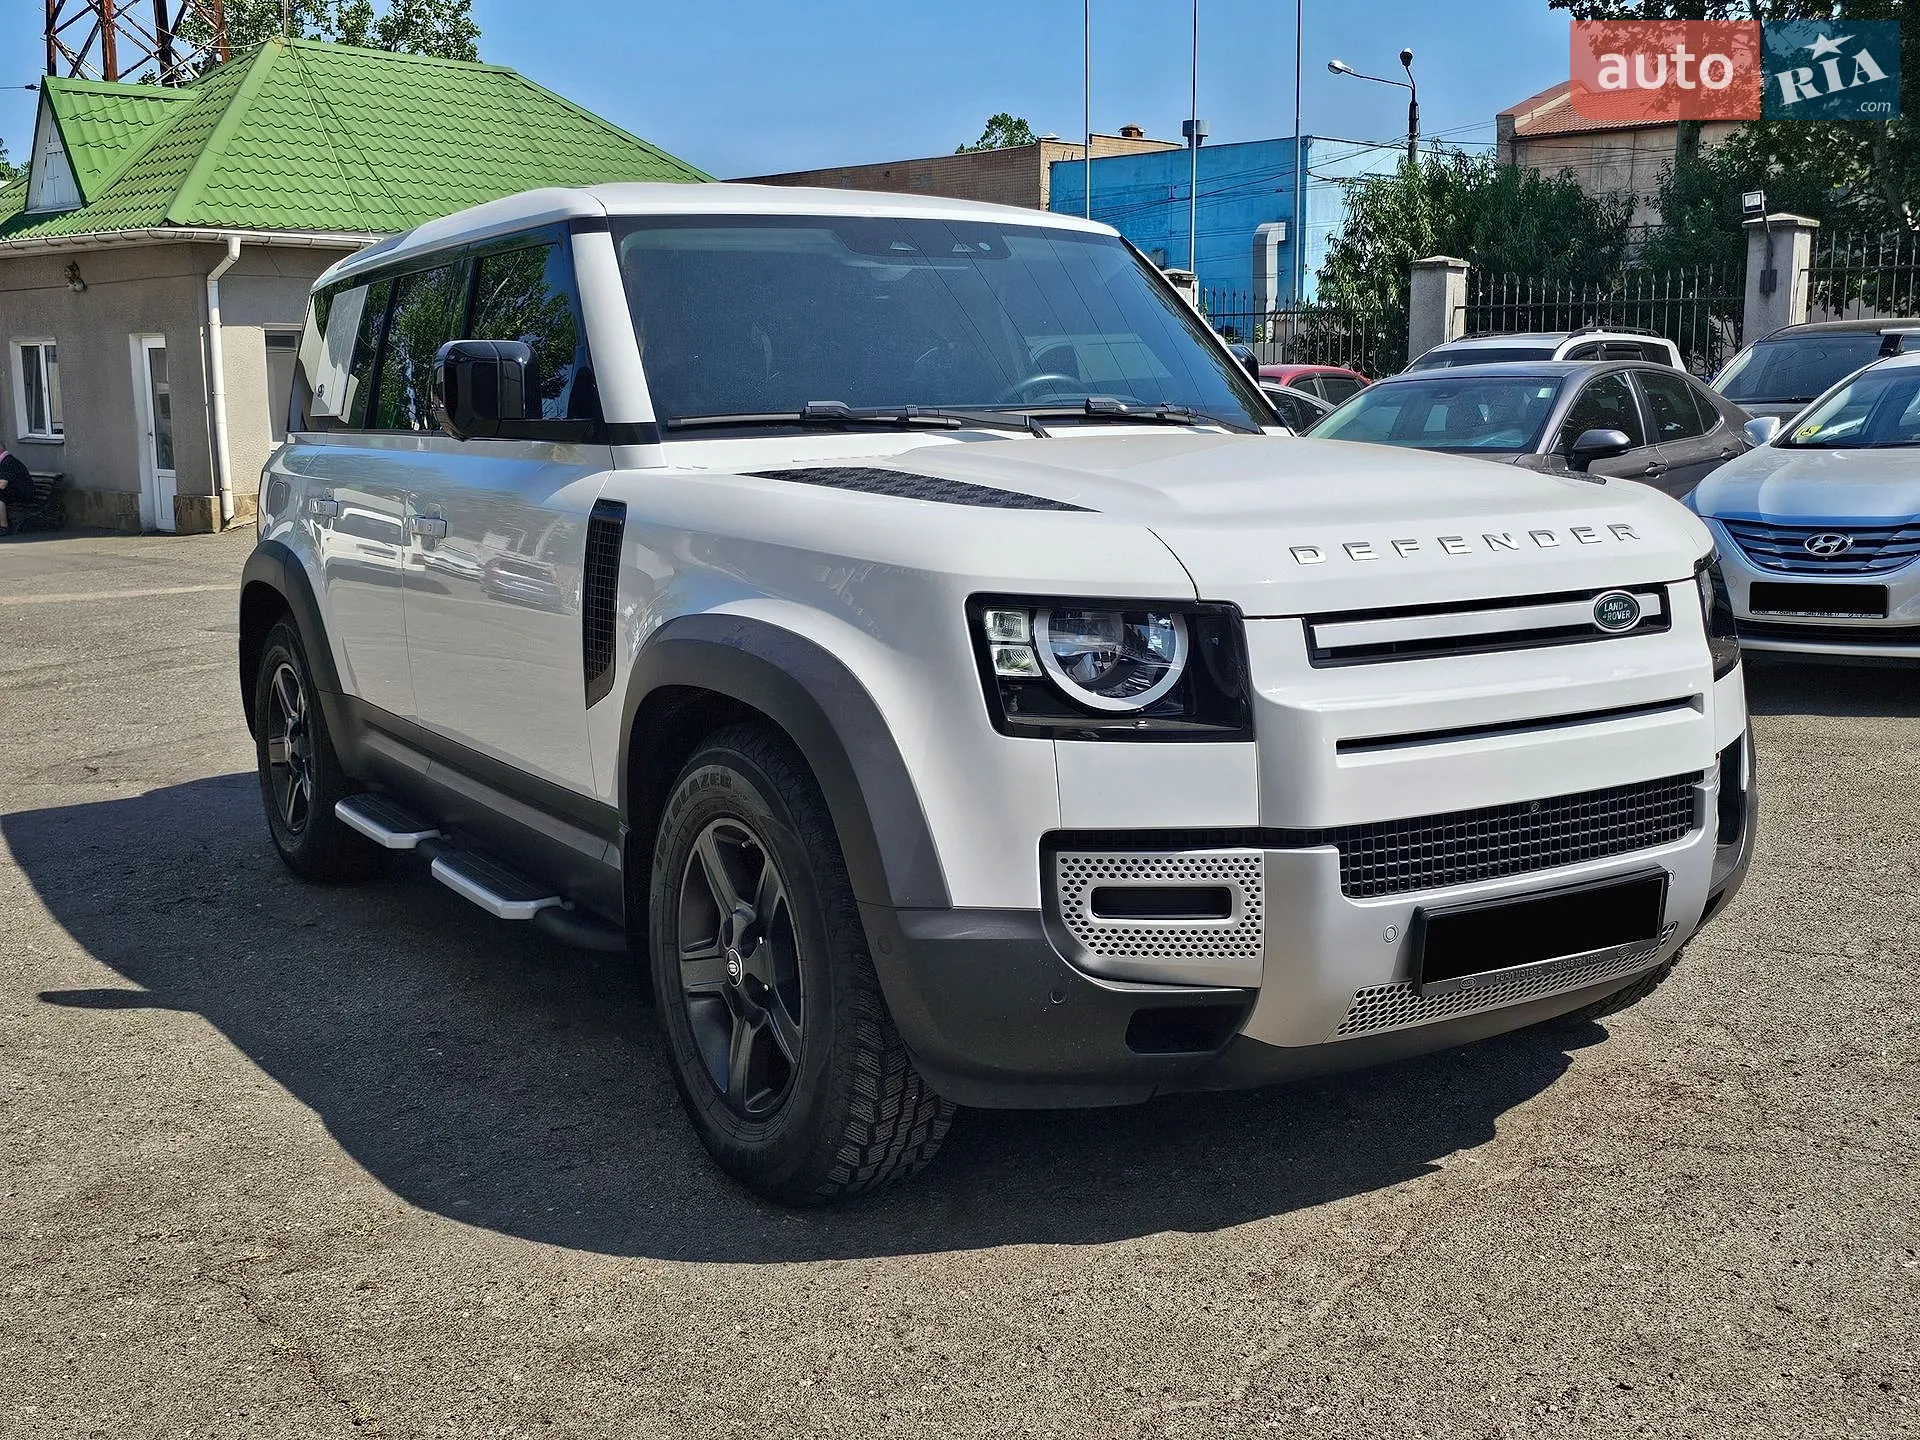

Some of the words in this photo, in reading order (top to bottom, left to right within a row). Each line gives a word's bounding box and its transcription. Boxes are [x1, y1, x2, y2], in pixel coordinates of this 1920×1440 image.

[1289, 522, 1641, 565] DEFENDER
[1604, 601, 1624, 612] LAND
[1606, 609, 1631, 621] ROVER
